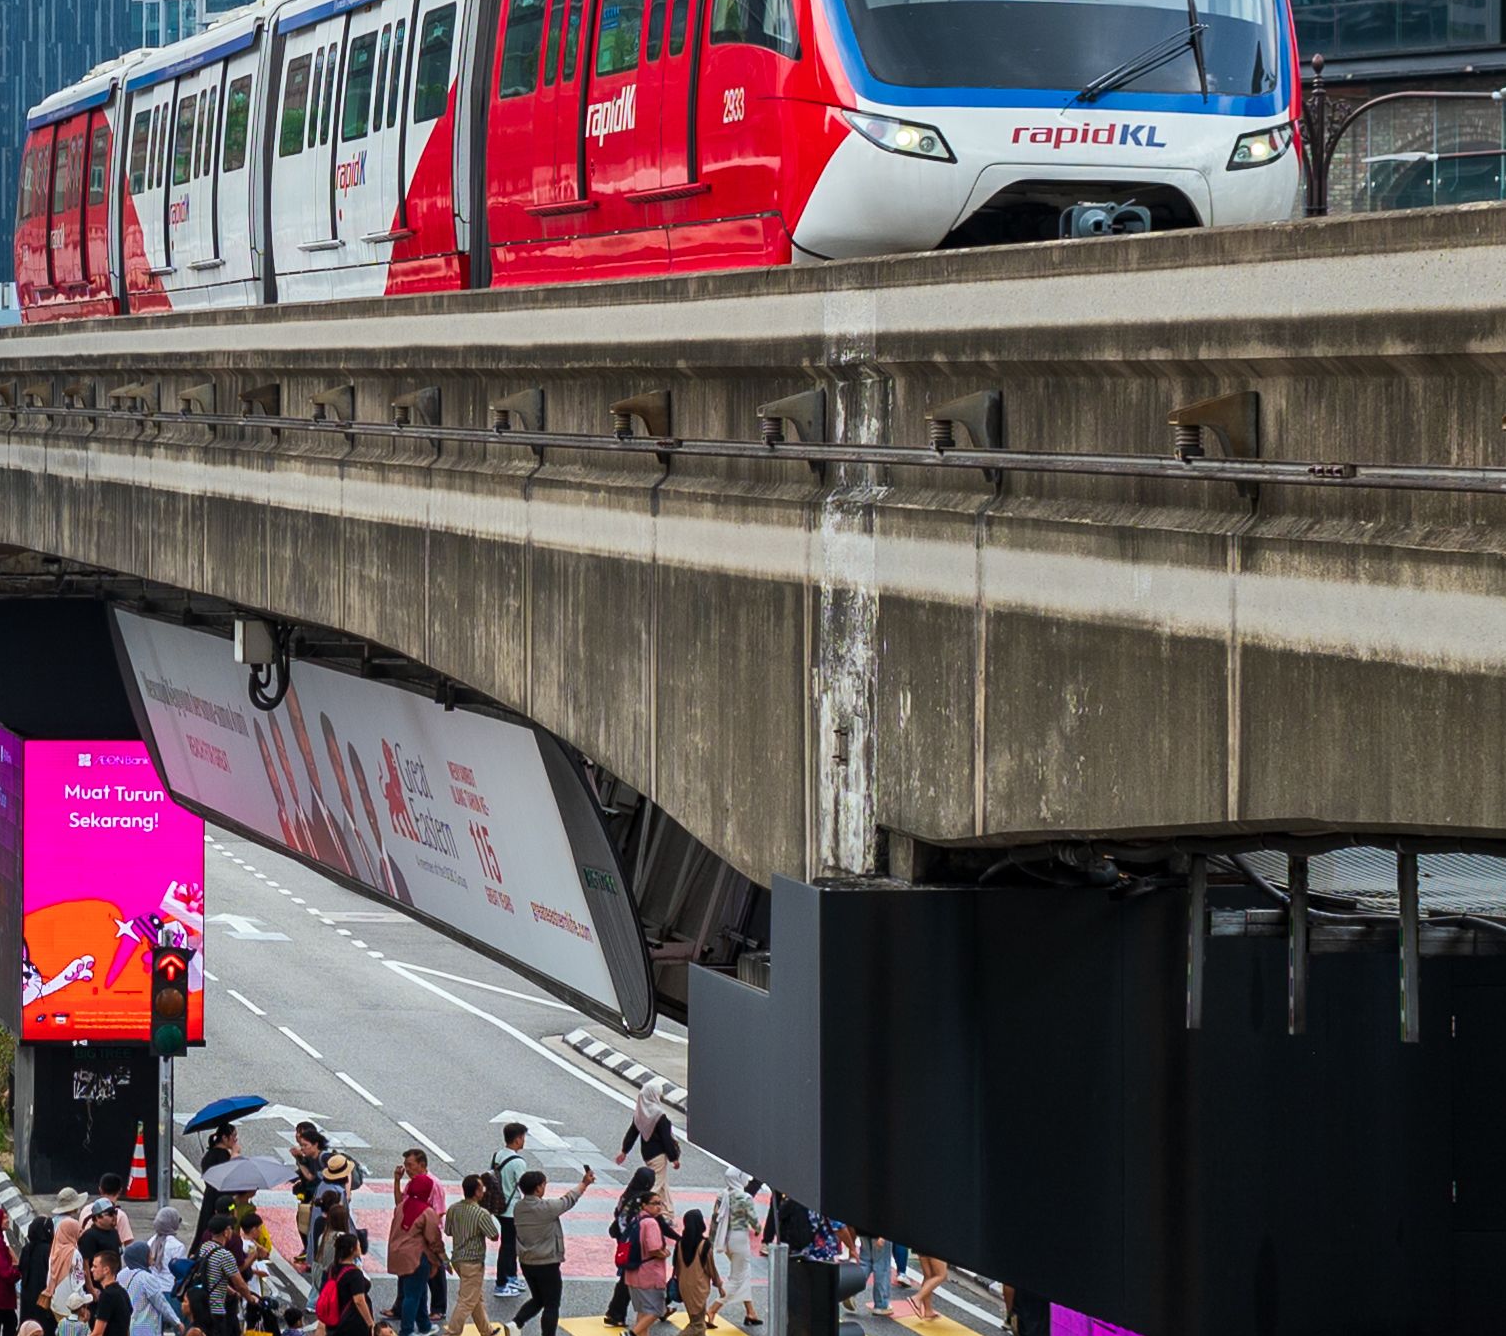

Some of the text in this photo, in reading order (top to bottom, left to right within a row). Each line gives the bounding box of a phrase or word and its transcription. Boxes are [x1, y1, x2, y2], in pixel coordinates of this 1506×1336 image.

[722, 87, 745, 125] 2933
[1012, 122, 1166, 149] rapidKL
[394, 742, 433, 800] Great
[65, 784, 164, 802] Muat Turun
[69, 812, 159, 832] Sekarang!
[408, 797, 460, 859] Eastern
[469, 819, 502, 884] 115
